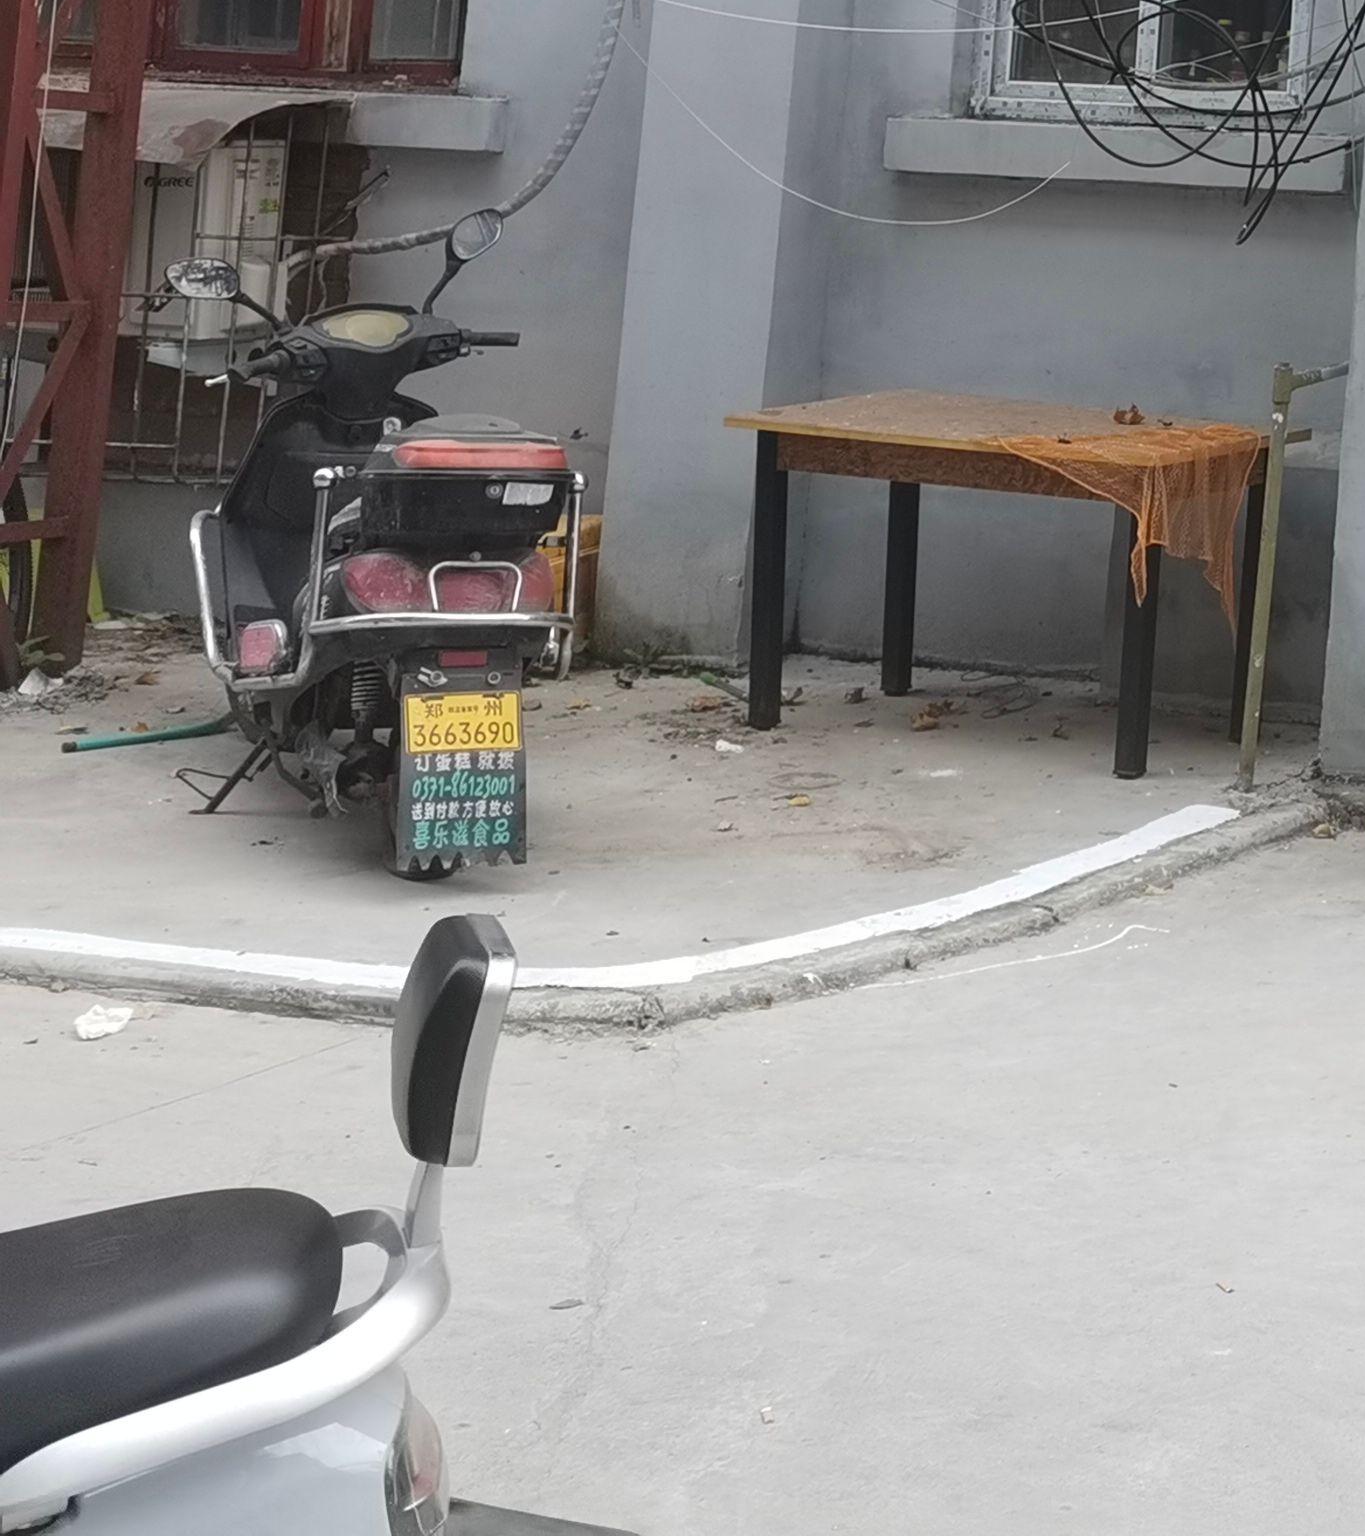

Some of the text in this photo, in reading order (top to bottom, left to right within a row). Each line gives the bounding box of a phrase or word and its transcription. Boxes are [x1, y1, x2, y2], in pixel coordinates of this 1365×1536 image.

[425, 702, 444, 719] 郑
[484, 699, 503, 717] 州
[413, 721, 514, 748] 3663690
[412, 770, 515, 802] 0371-86123001
